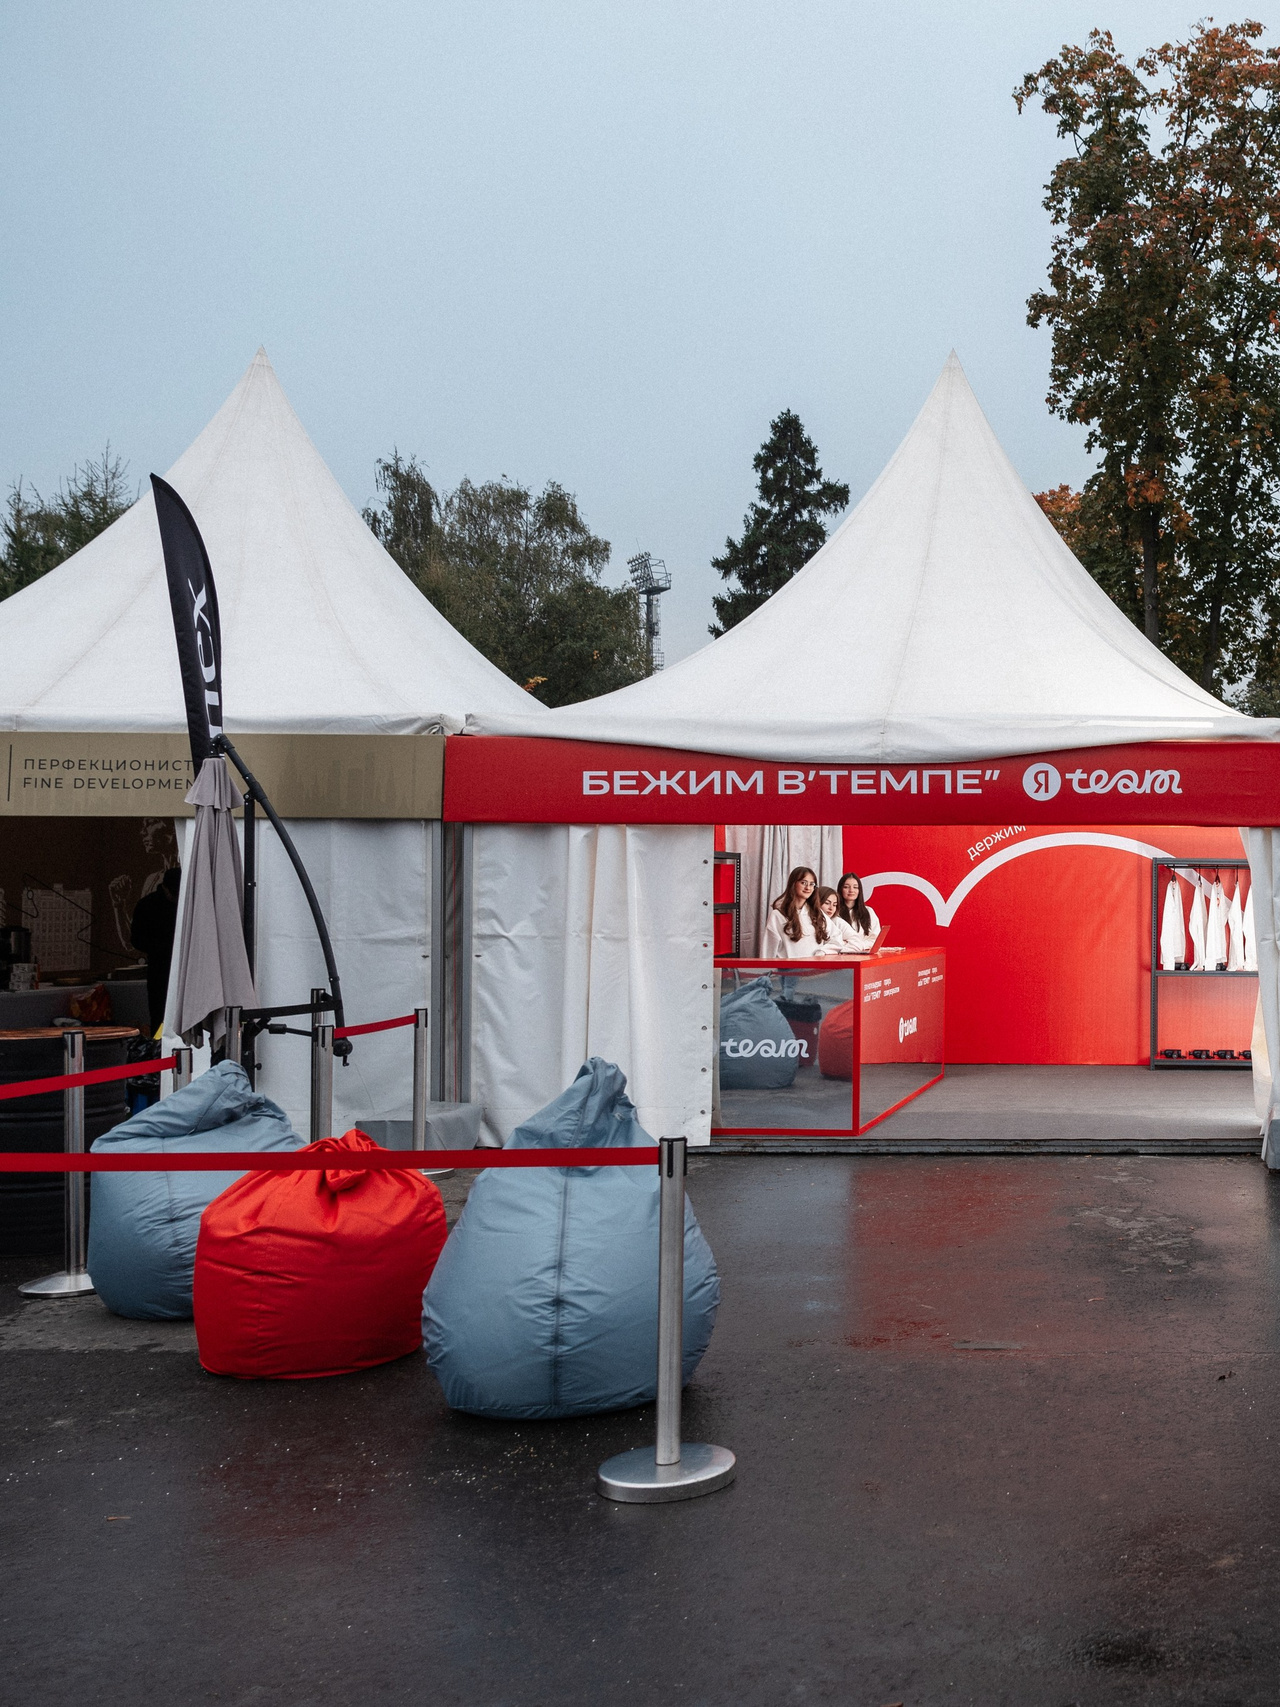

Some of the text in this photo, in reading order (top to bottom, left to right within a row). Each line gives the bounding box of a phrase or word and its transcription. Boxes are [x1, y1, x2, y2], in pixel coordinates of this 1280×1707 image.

[24, 758, 193, 773] ПЕРФЕКЦИОНИСТ
[23, 777, 63, 789] FINE
[582, 770, 764, 795] БЕЖИМ
[1065, 768, 1183, 794] team
[966, 825, 1027, 861] держим
[720, 1038, 810, 1058] team
